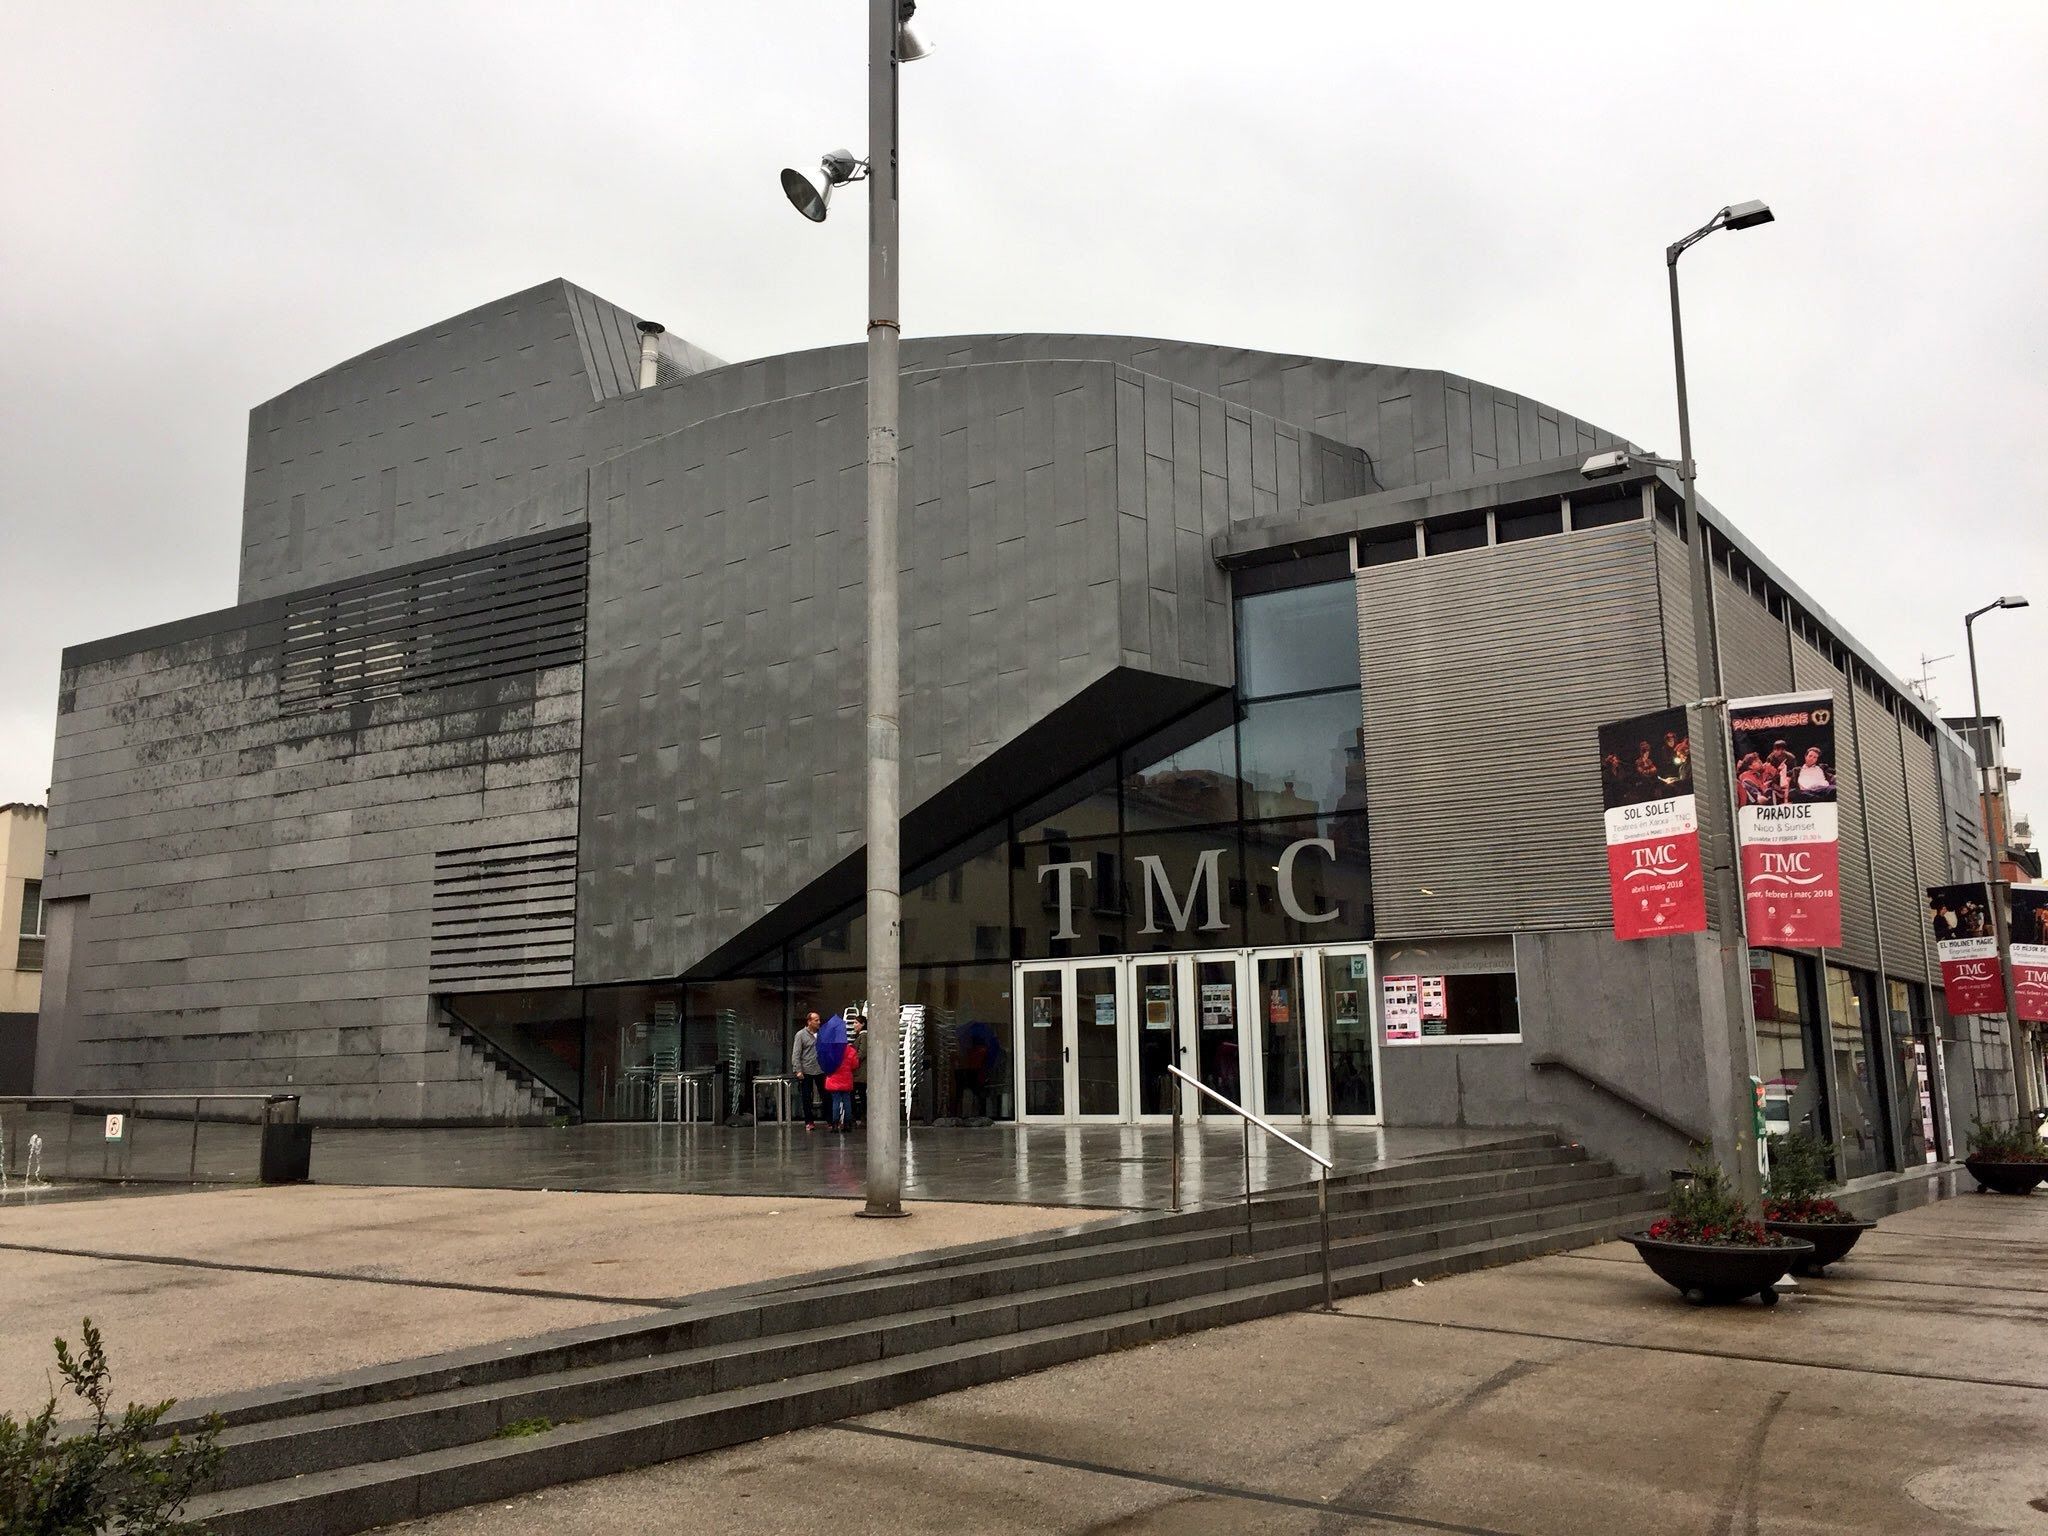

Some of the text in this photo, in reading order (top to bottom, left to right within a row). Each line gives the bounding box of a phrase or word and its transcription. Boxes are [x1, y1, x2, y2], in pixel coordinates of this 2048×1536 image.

[1732, 712, 1809, 731] PARADISE
[1624, 801, 1675, 820] SOL SOLET
[1675, 813, 1691, 821] TNC
[1757, 805, 1811, 820] PARADISE
[1753, 822, 1815, 832] Nico & Sunset
[1632, 844, 1677, 868] TMC
[1760, 852, 1811, 873] TMC
[1037, 838, 1340, 940] TMC
[1667, 880, 1684, 889] 2018
[1765, 889, 1788, 898] febrer
[1794, 890, 1812, 900] març
[1813, 889, 1834, 898] 2018
[1956, 963, 1987, 975] TMC
[2024, 970, 2048, 982] TM
